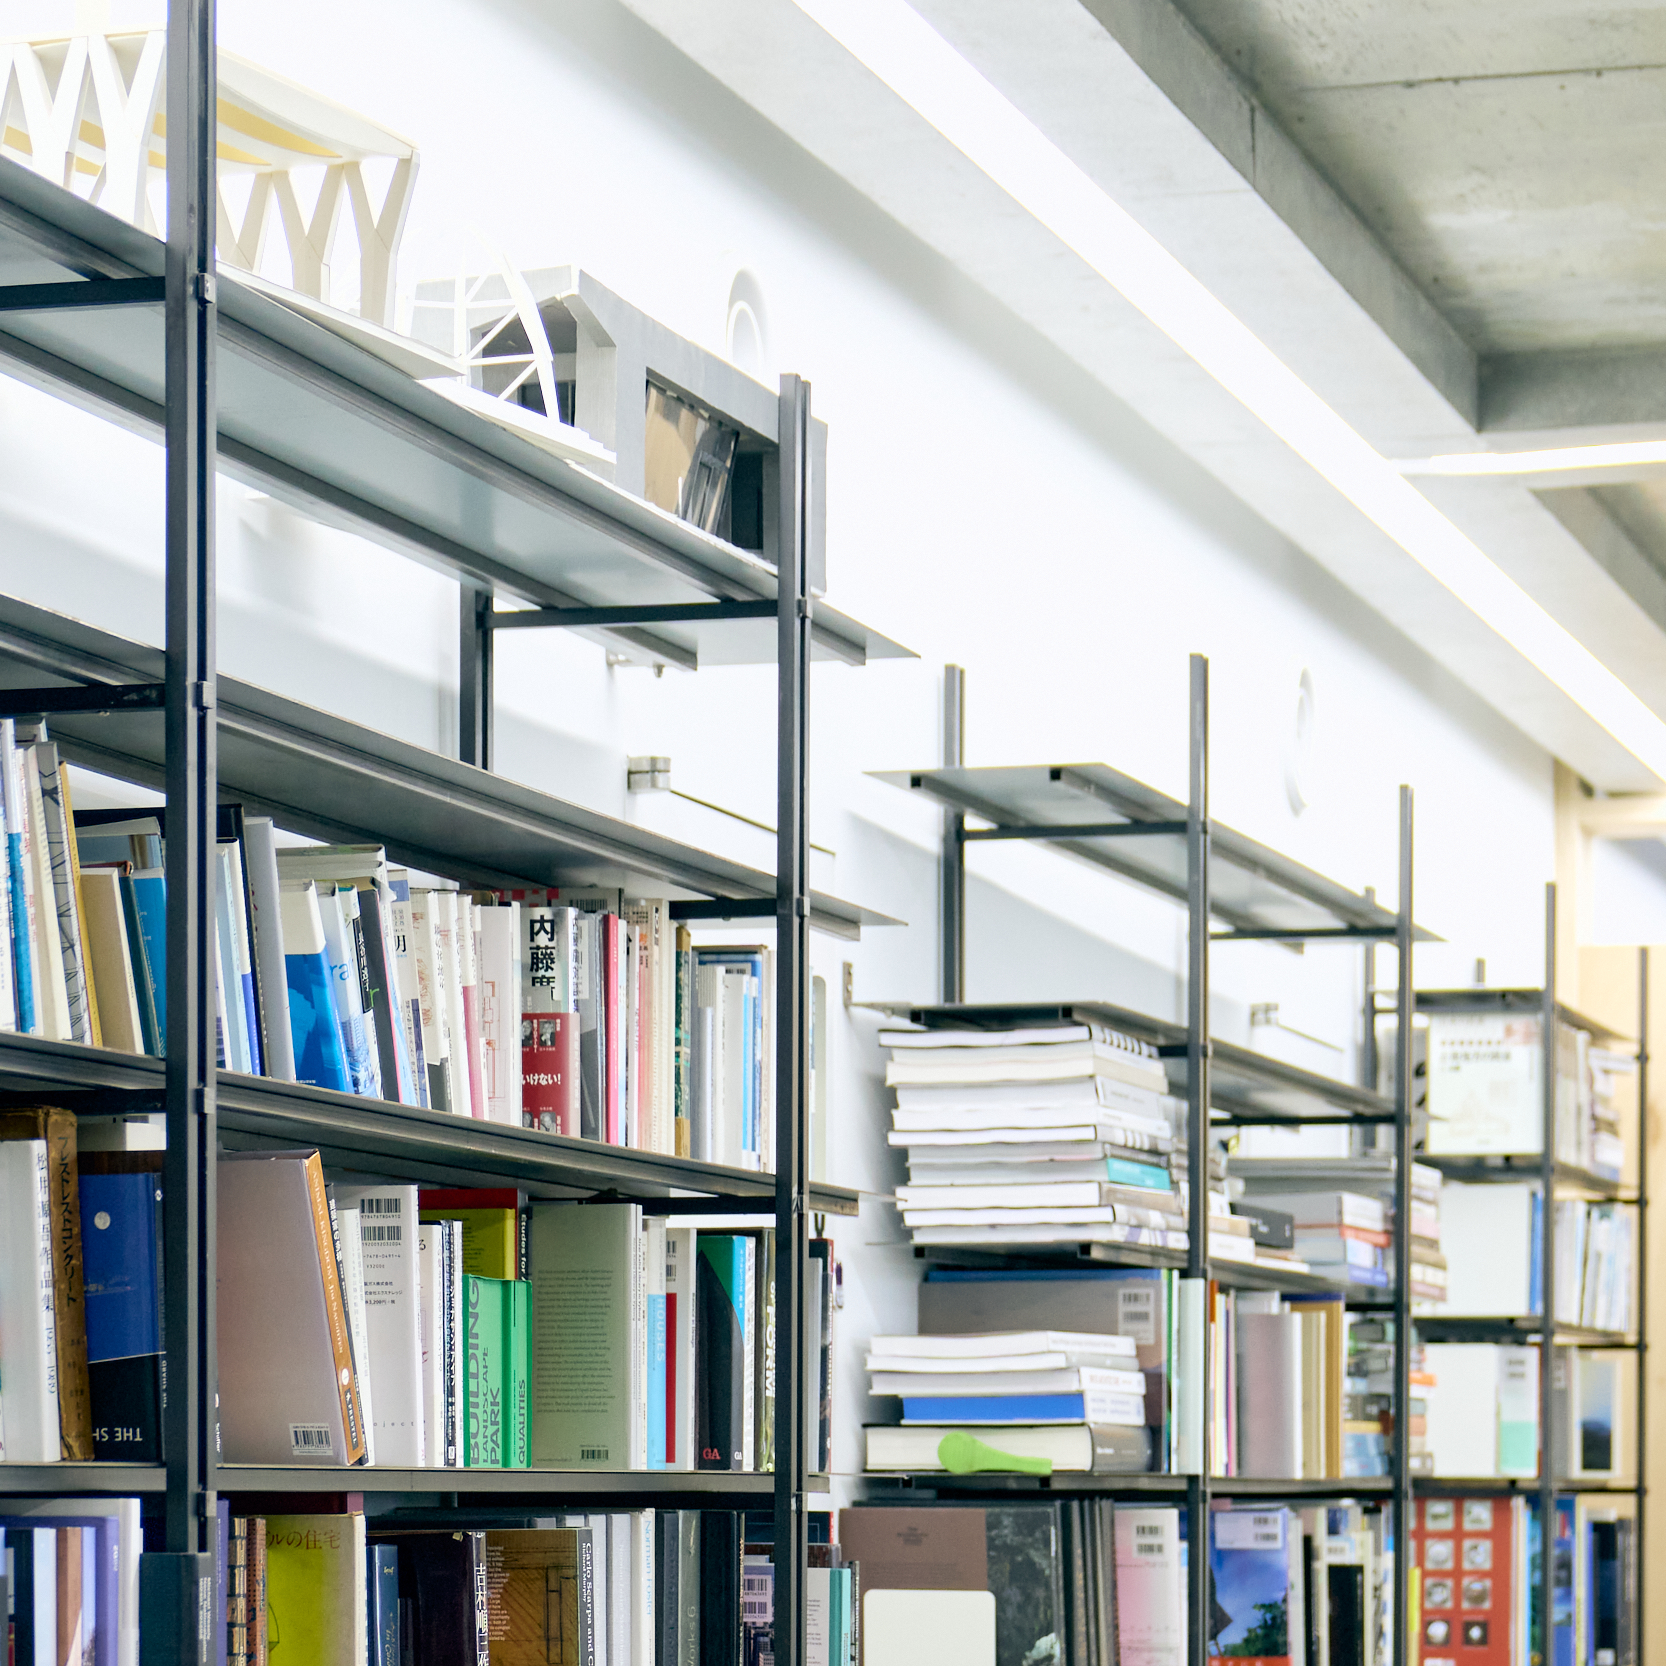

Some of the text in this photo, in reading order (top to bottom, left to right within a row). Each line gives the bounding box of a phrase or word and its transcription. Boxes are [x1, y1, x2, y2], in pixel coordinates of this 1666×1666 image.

[312, 1172, 332, 1280] ANIMAL KINGDOM
[657, 1297, 665, 1362] HOUSES
[470, 1280, 480, 1465] BUILDING
[481, 1347, 489, 1463] LANDSCAPE
[348, 1403, 358, 1443] PRESTEL
[491, 1387, 499, 1464] PARK
[703, 1448, 721, 1460] GA
[585, 1542, 593, 1581] Carlo
[687, 1606, 695, 1619] 6
